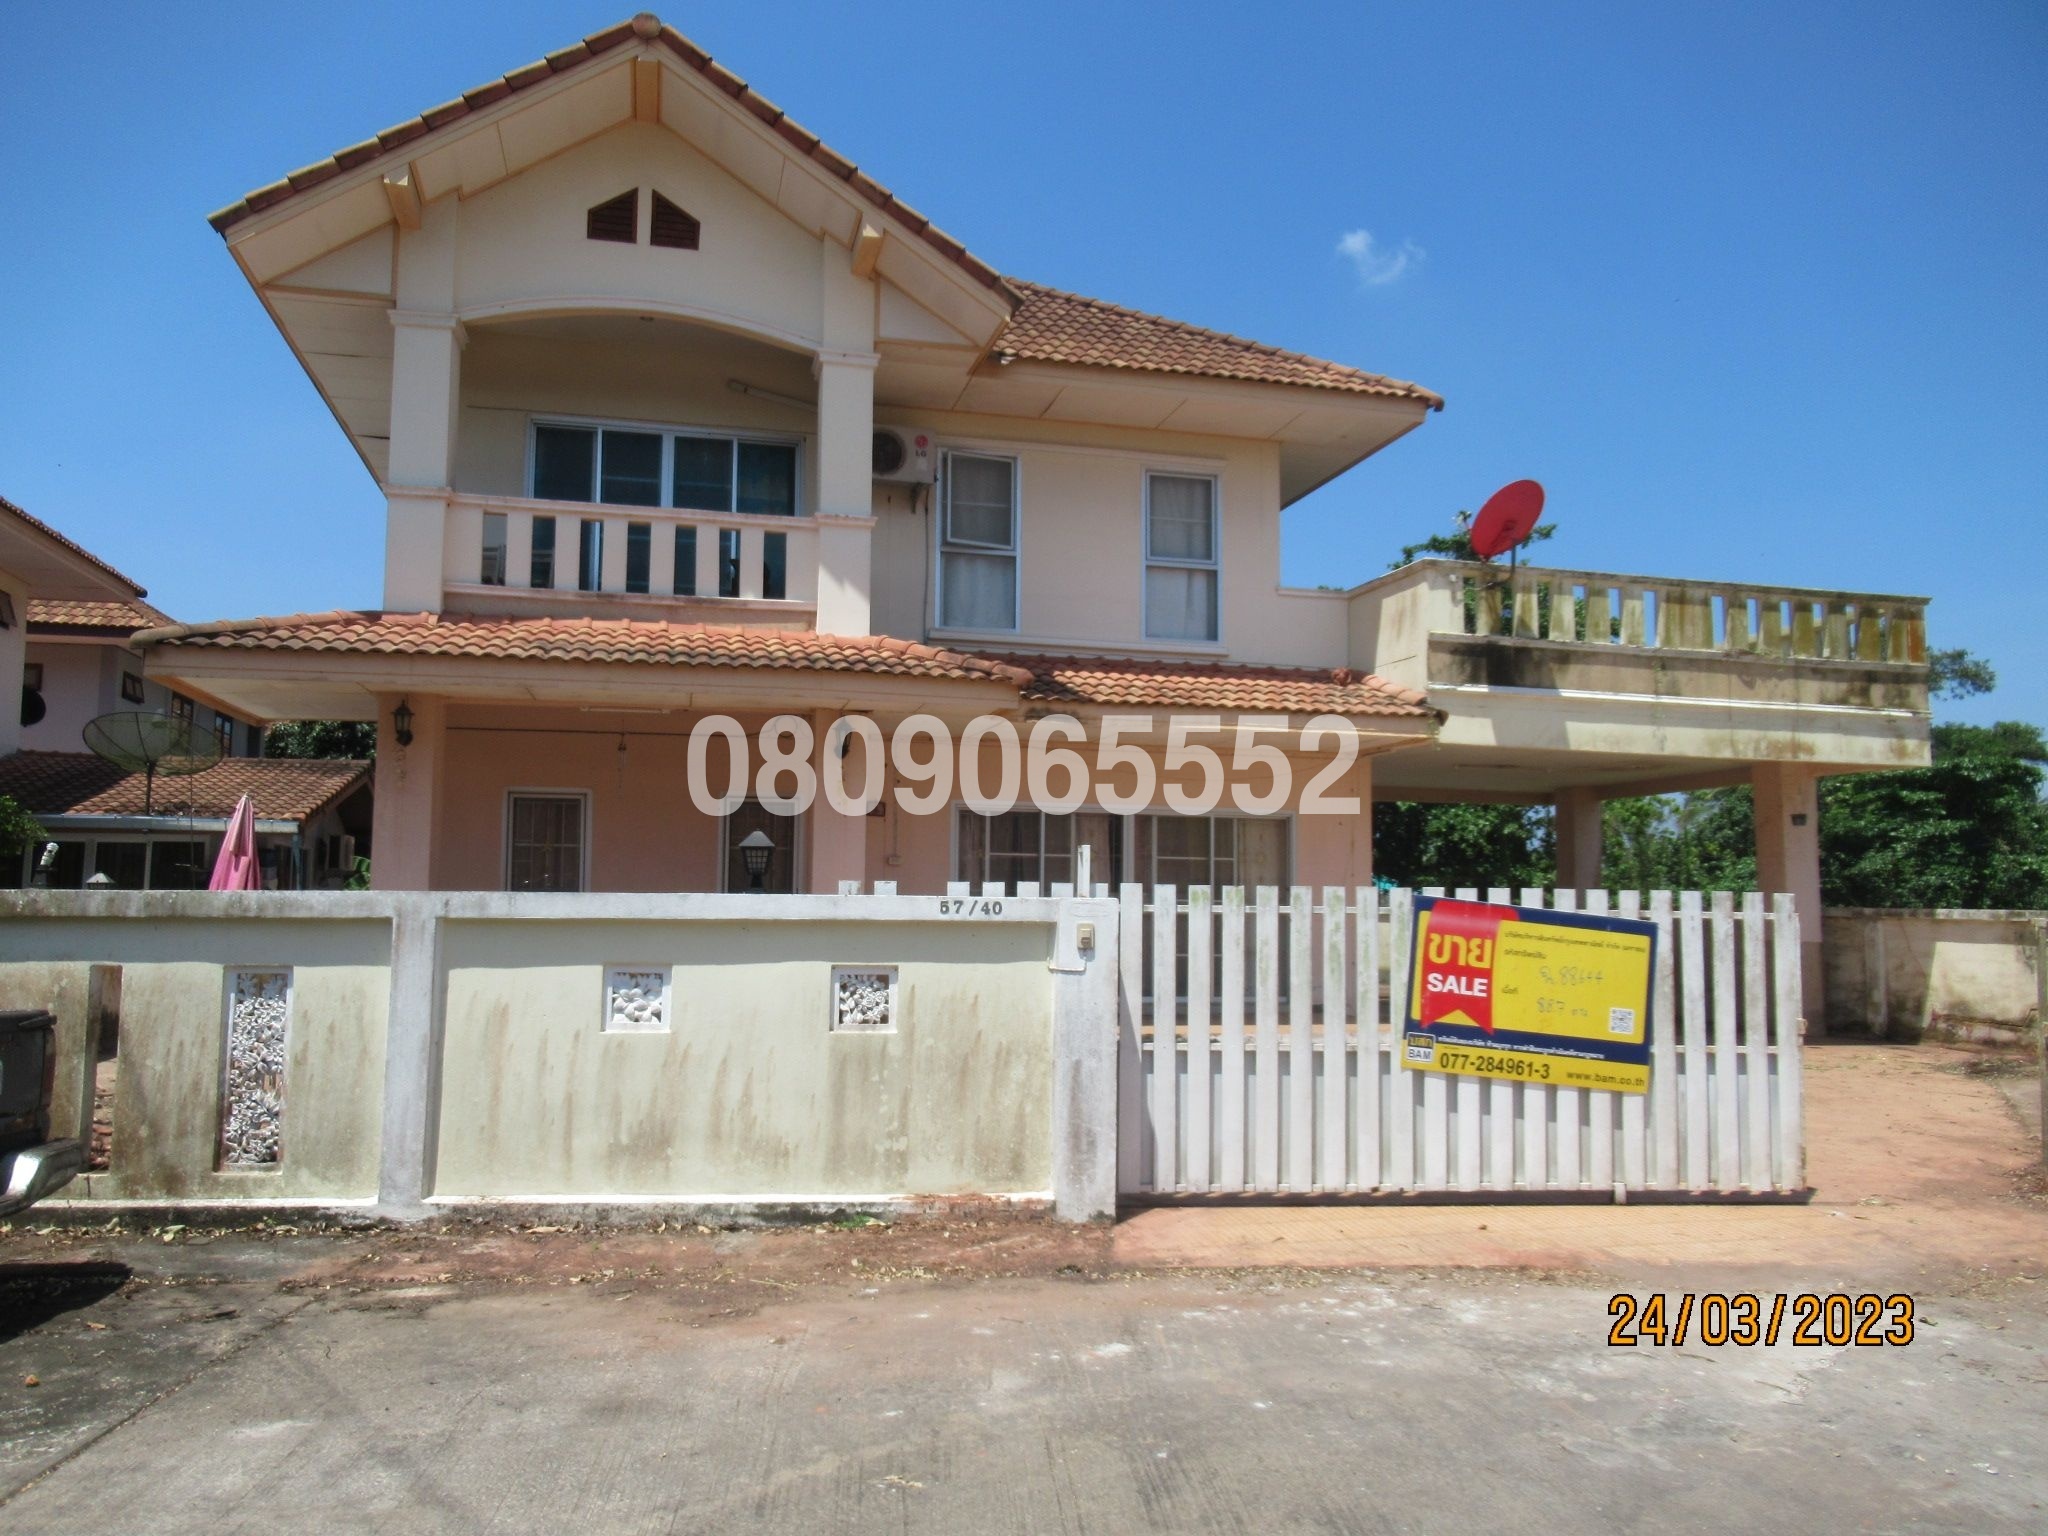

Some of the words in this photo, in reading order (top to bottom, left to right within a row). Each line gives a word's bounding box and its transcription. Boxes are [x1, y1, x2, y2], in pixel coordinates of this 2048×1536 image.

[940, 900, 1003, 916] 57/40
[1429, 933, 1493, 969] ขาย
[1427, 972, 1488, 997] SALE
[1408, 1048, 1431, 1060] BAM
[1440, 1053, 1550, 1079] 077-284961-3
[1566, 1071, 1645, 1087] www.bam.co.th
